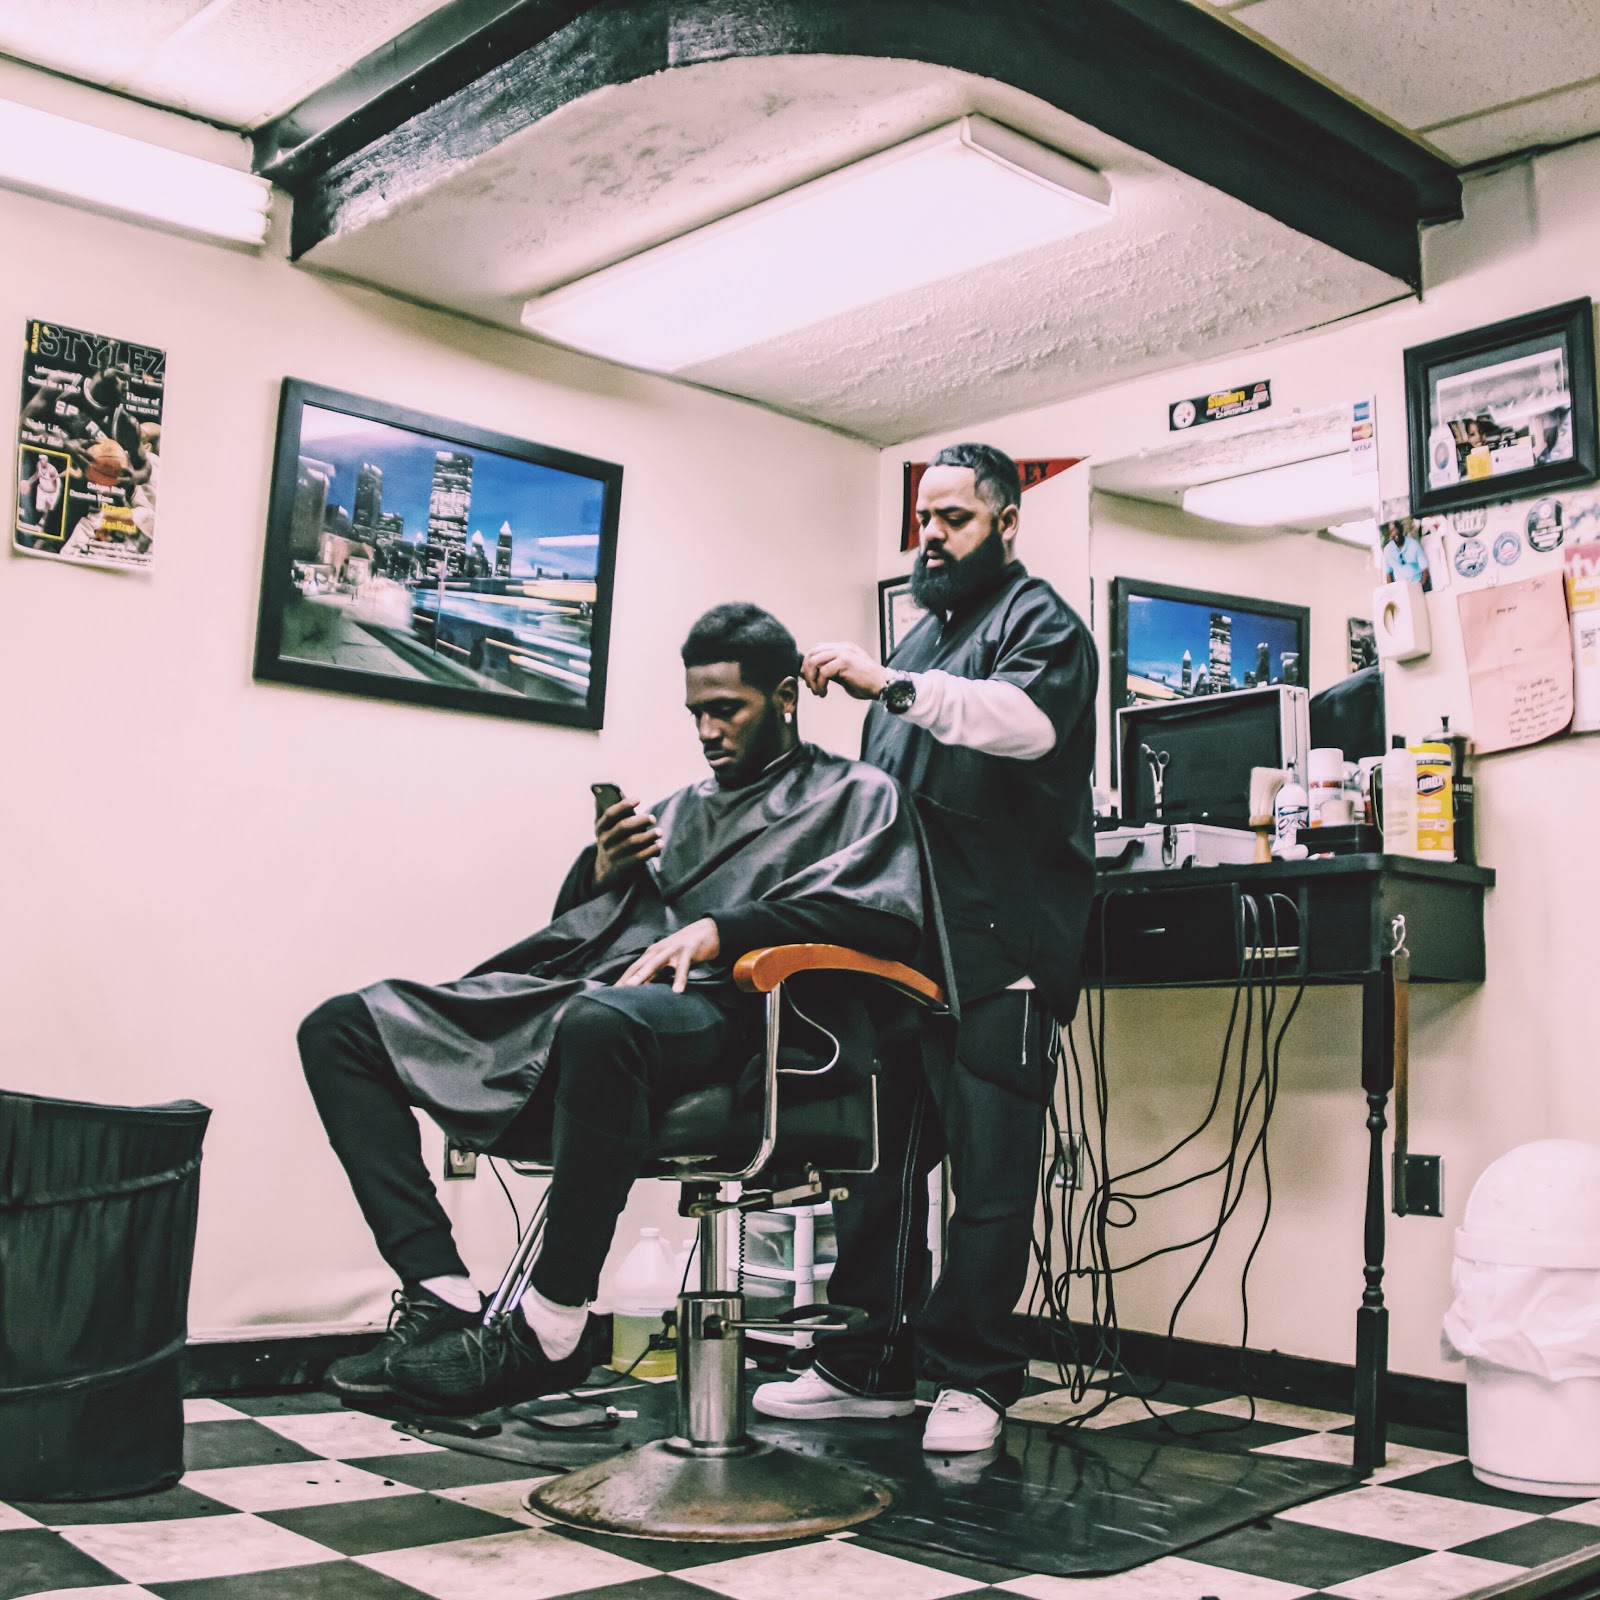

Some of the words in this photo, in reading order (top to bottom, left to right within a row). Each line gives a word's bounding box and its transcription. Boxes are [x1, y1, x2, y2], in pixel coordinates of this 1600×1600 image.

[40, 324, 165, 381] STYLEZ
[127, 392, 150, 404] Flavor
[151, 397, 160, 405] of
[102, 519, 137, 533] Realized
[1418, 775, 1444, 791] OROX
